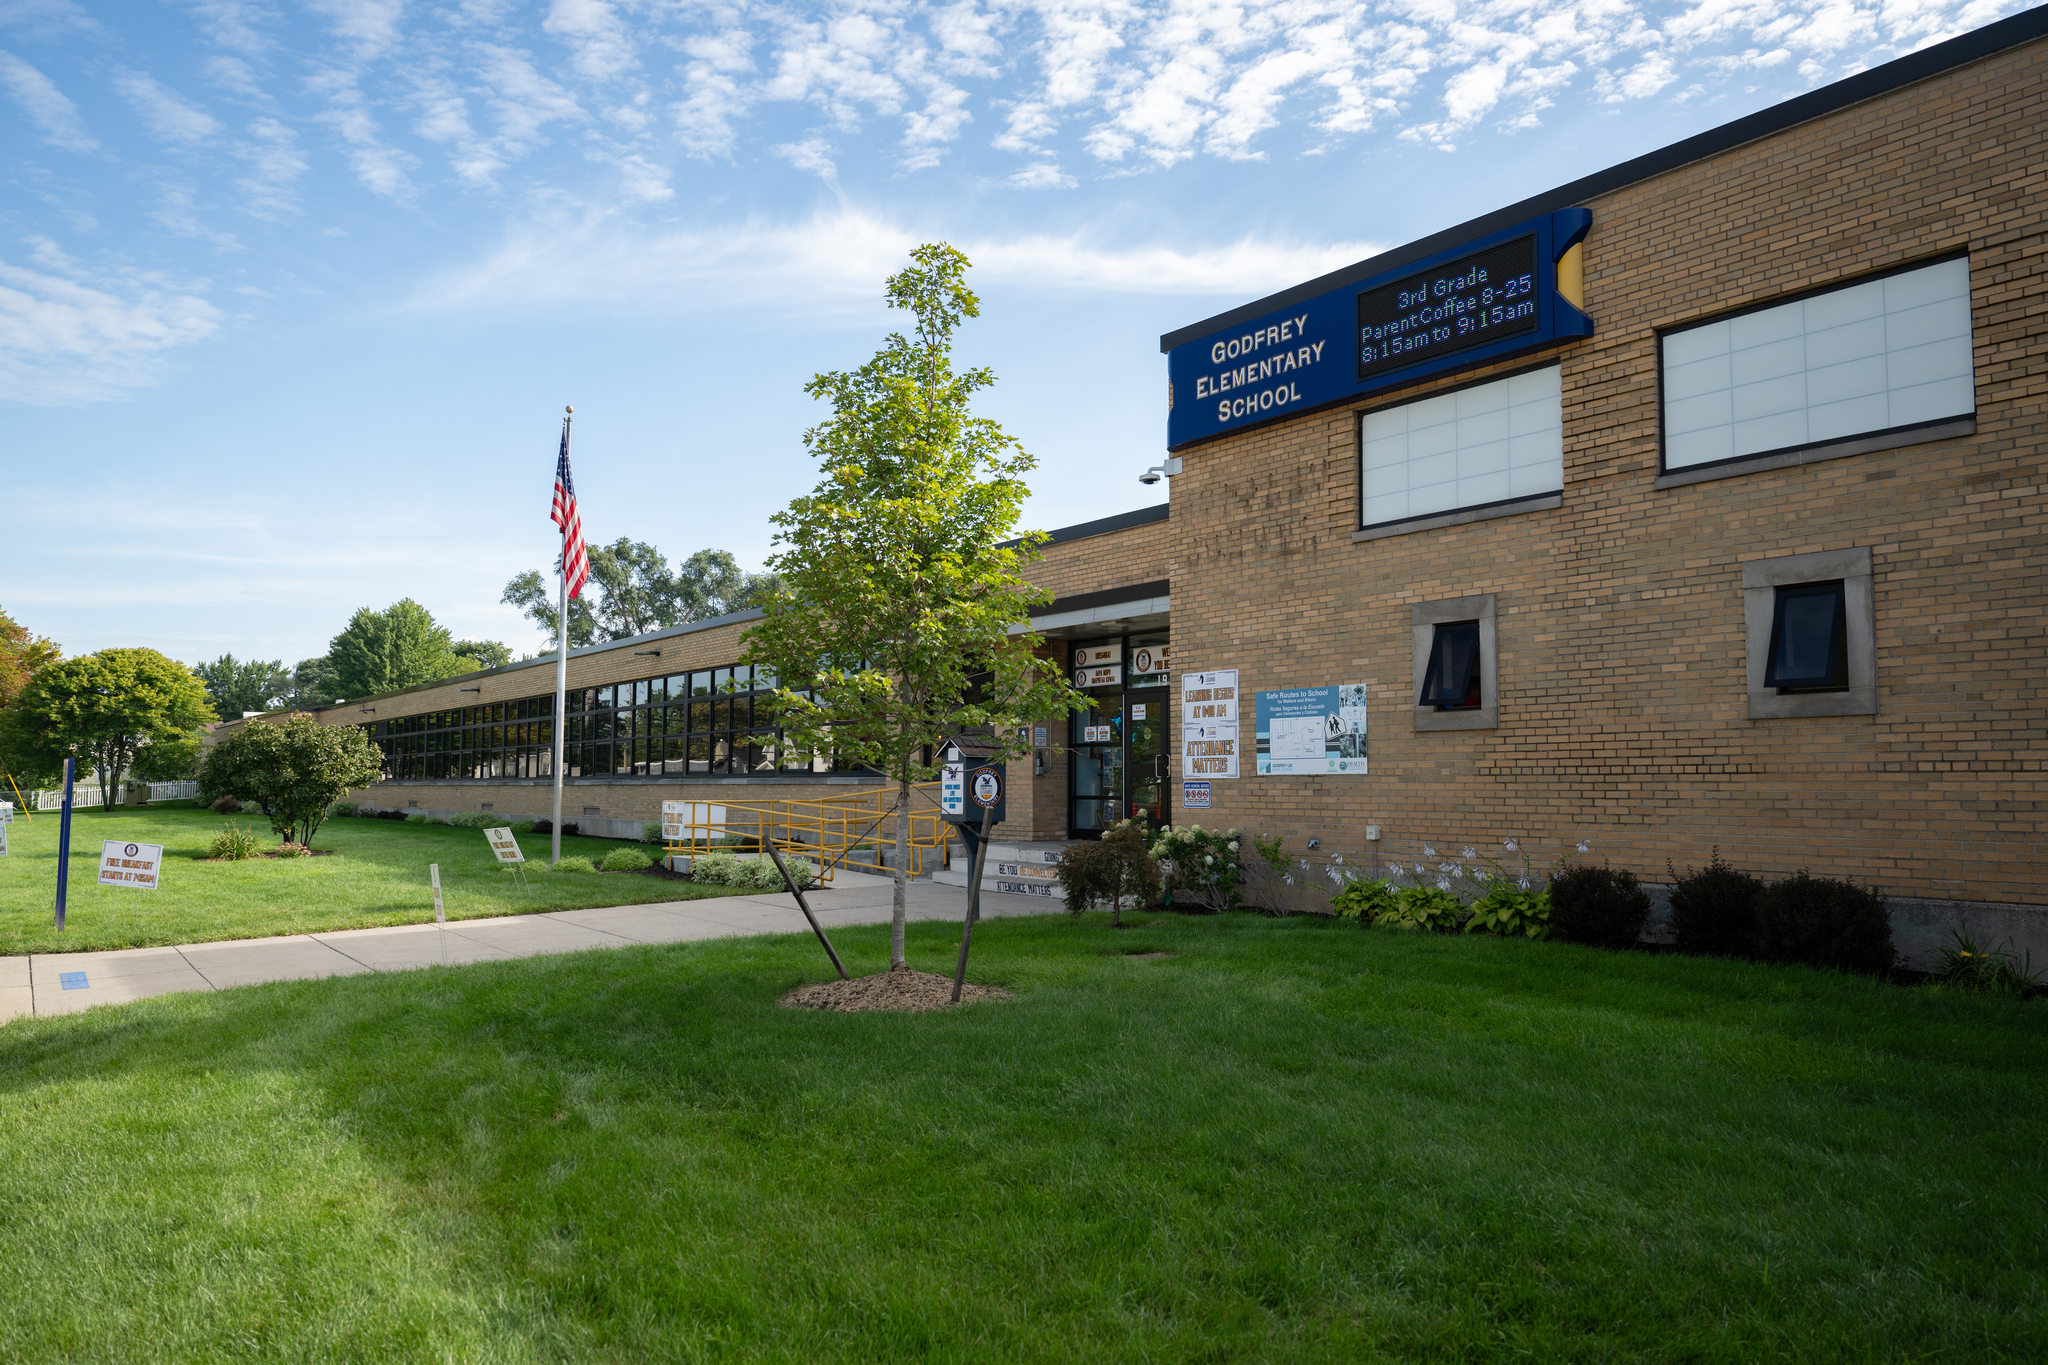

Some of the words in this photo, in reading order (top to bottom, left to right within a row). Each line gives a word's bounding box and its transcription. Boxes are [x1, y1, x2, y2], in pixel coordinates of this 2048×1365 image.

[1397, 281, 1428, 311] 3rd
[1432, 265, 1489, 298] Grade
[1481, 272, 1532, 306] 8-25
[1211, 313, 1309, 366] GODFREY
[1361, 332, 1430, 365] 8:15am
[1431, 325, 1452, 343] to
[1457, 300, 1535, 337] 9:15am
[1196, 339, 1326, 401] ELEMENTARY
[1218, 381, 1302, 423] SCHOOL
[1185, 689, 1212, 703] LEARNING
[1213, 687, 1234, 701] BEGINS
[1266, 692, 1278, 700] Safe
[1279, 690, 1299, 699] Routes
[1307, 689, 1328, 698] School
[1193, 705, 1201, 718] AT
[1216, 703, 1227, 718] AM
[1186, 740, 1235, 757] ATTENDANCE
[1192, 757, 1228, 773] MATTERS
[976, 769, 997, 778] GODFREY
[106, 857, 121, 867] FREE
[121, 859, 154, 871] BREAKFAST
[998, 863, 1007, 875] BE
[1007, 865, 1018, 876] YOU
[1020, 866, 1027, 877] BE
[1027, 867, 1058, 880] CONNECTED
[101, 869, 123, 881] STARTS
[124, 871, 132, 882] AT
[996, 881, 1027, 894] ATTENDANCE
[1028, 883, 1052, 896] MATTERS
